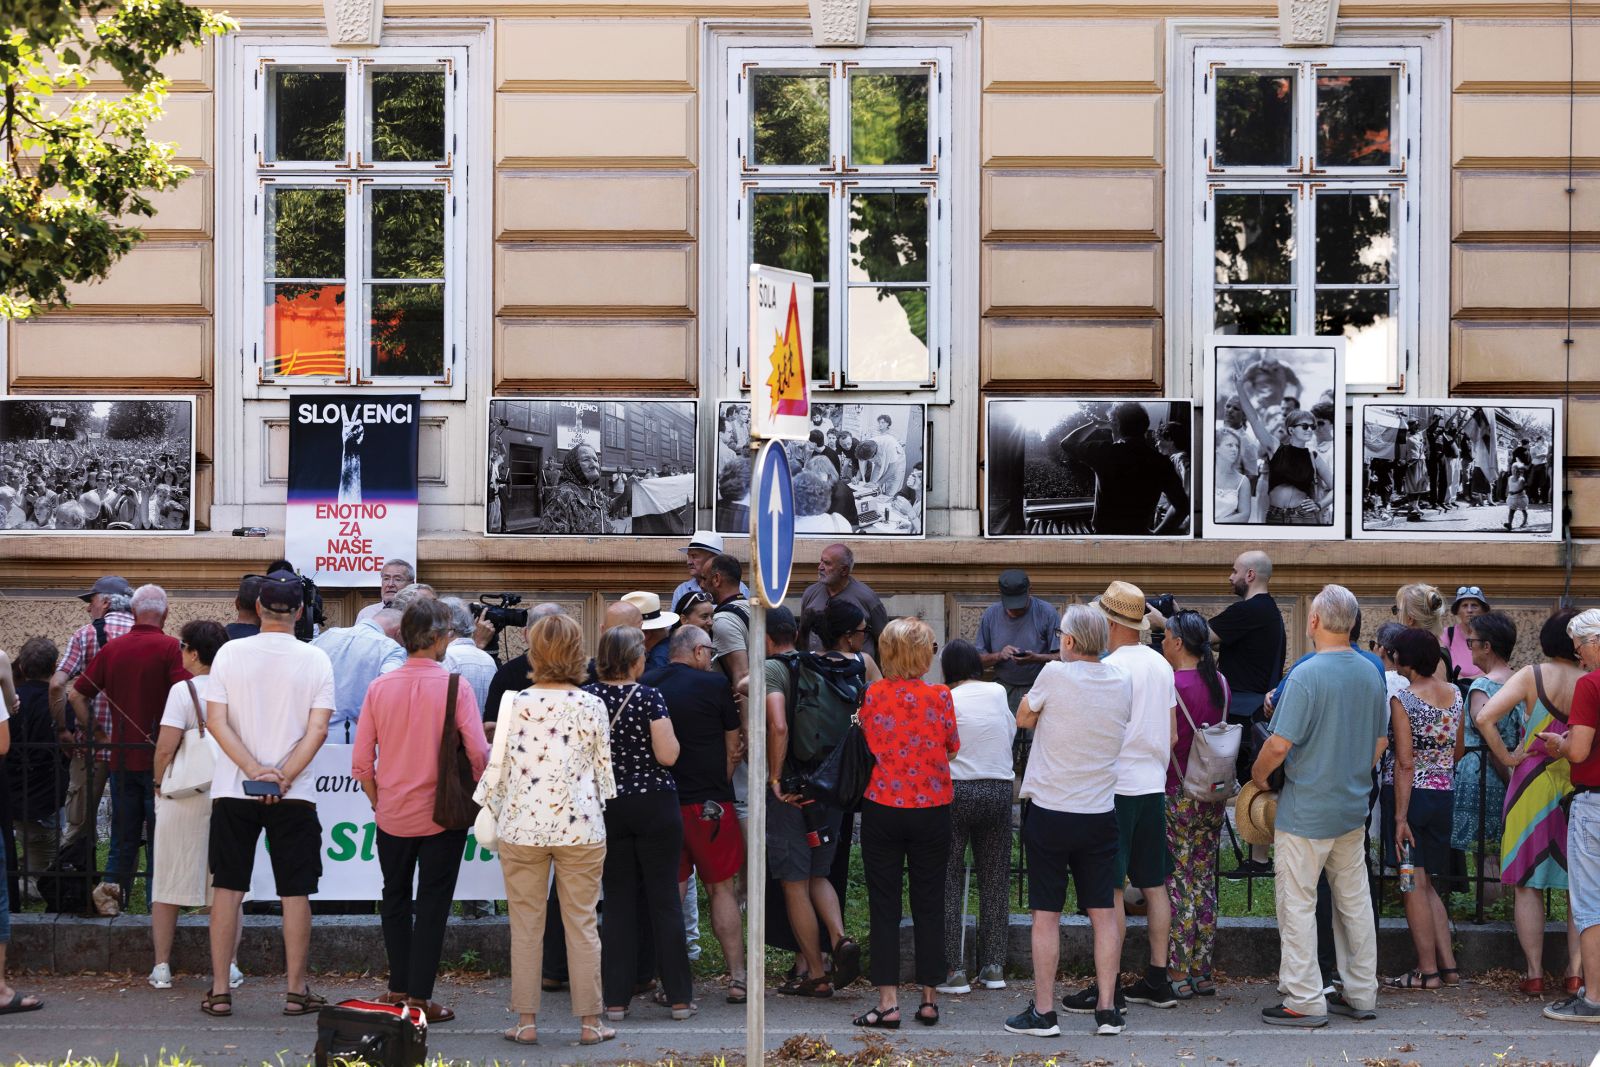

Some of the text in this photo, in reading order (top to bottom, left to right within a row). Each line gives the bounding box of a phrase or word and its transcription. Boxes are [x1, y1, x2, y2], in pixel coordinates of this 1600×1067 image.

[298, 403, 412, 424] SLOVENCI
[315, 503, 387, 519] ENOTNO
[338, 521, 362, 537] ZA
[327, 536, 373, 554] NAŠE
[315, 556, 384, 572] PRAVICE
[315, 775, 366, 793] avn
